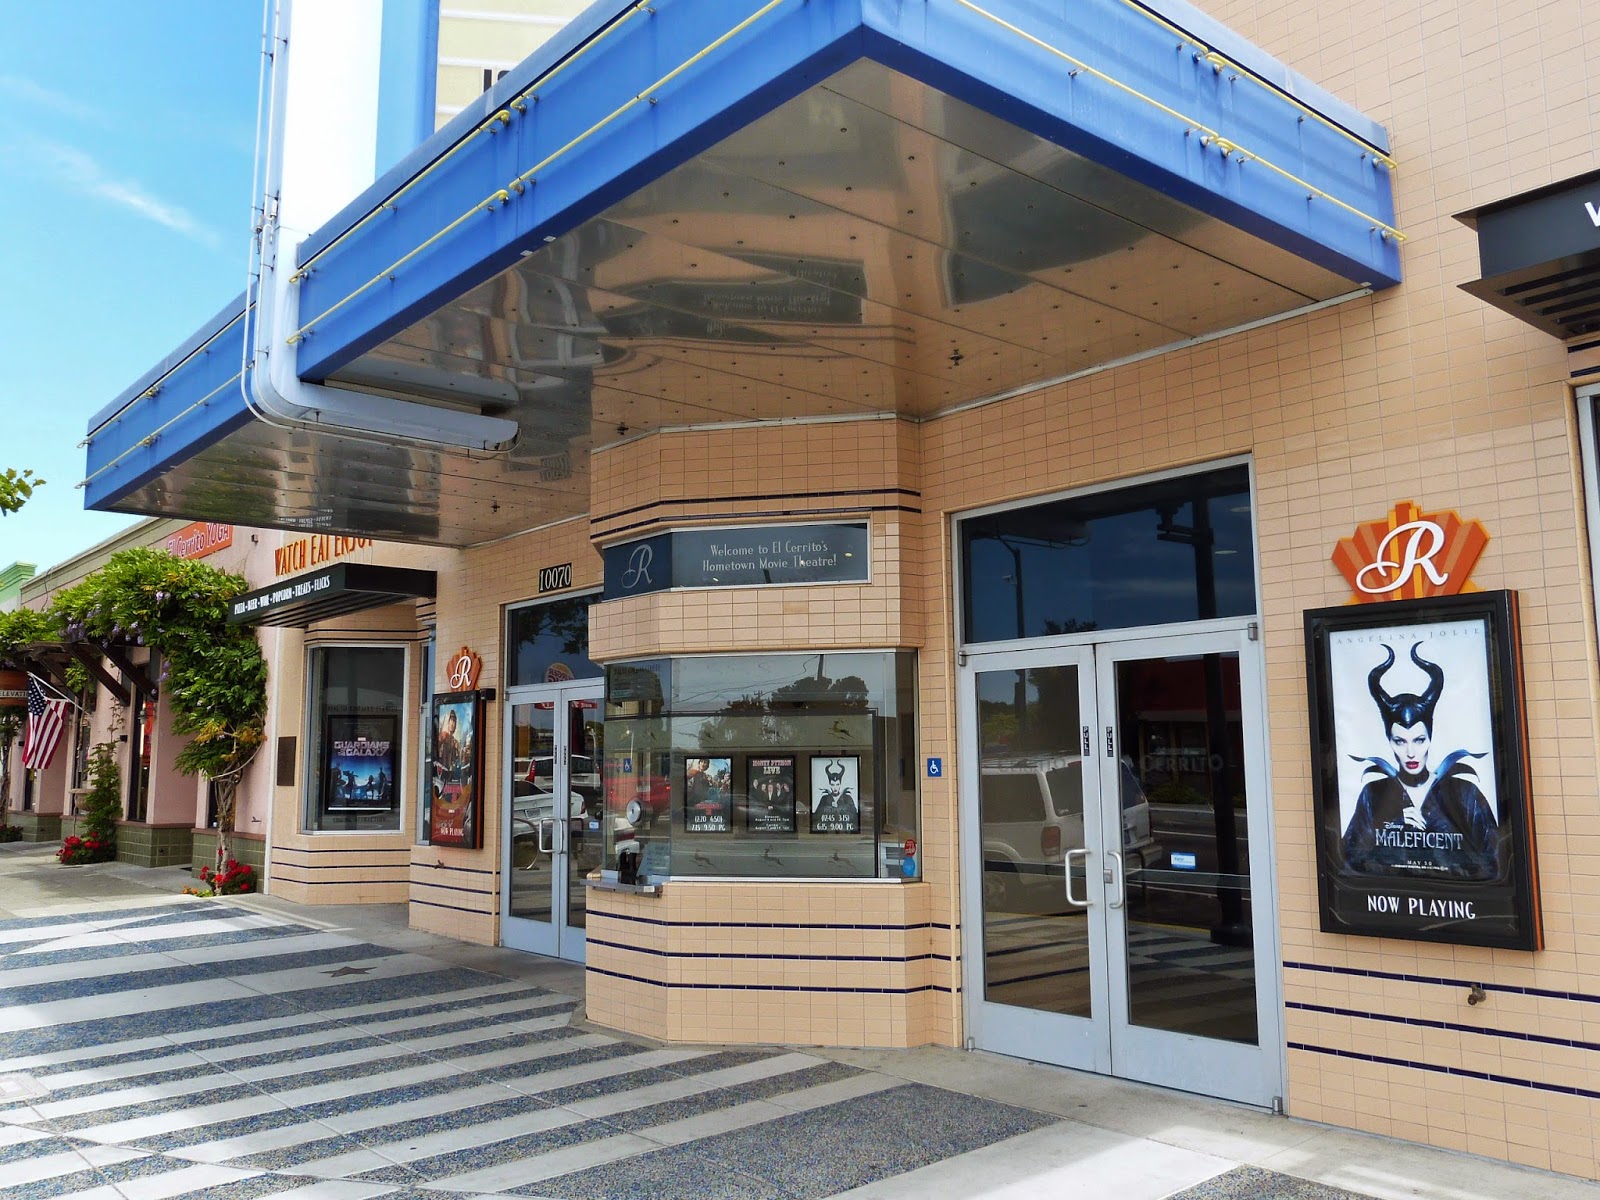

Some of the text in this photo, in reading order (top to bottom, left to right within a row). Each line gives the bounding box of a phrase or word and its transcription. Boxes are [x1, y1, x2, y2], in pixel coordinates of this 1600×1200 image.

[176, 530, 206, 559] Cerrito
[206, 522, 230, 548] YOGA
[711, 541, 828, 556] Welcome to El Cerrito's
[275, 539, 306, 577] WATCH
[703, 554, 837, 572] Hometown Movie Theatre!
[1356, 521, 1449, 594] R
[540, 564, 572, 592] 10070
[247, 598, 258, 611] BEER
[273, 588, 292, 603] POPCORN
[295, 581, 311, 597] TREATS
[314, 575, 330, 591] FLICKS
[1337, 627, 1480, 645] ANGELINA JOLIE
[450, 655, 472, 689] R
[334, 741, 390, 749] GUARDIANS
[345, 748, 388, 757] GALAXY
[763, 767, 781, 775] LIVE
[449, 827, 464, 837] PLAYING
[1383, 822, 1404, 831] Disney
[1375, 829, 1464, 851] MALEFICENT
[1367, 895, 1476, 919] NOW PLAYING
